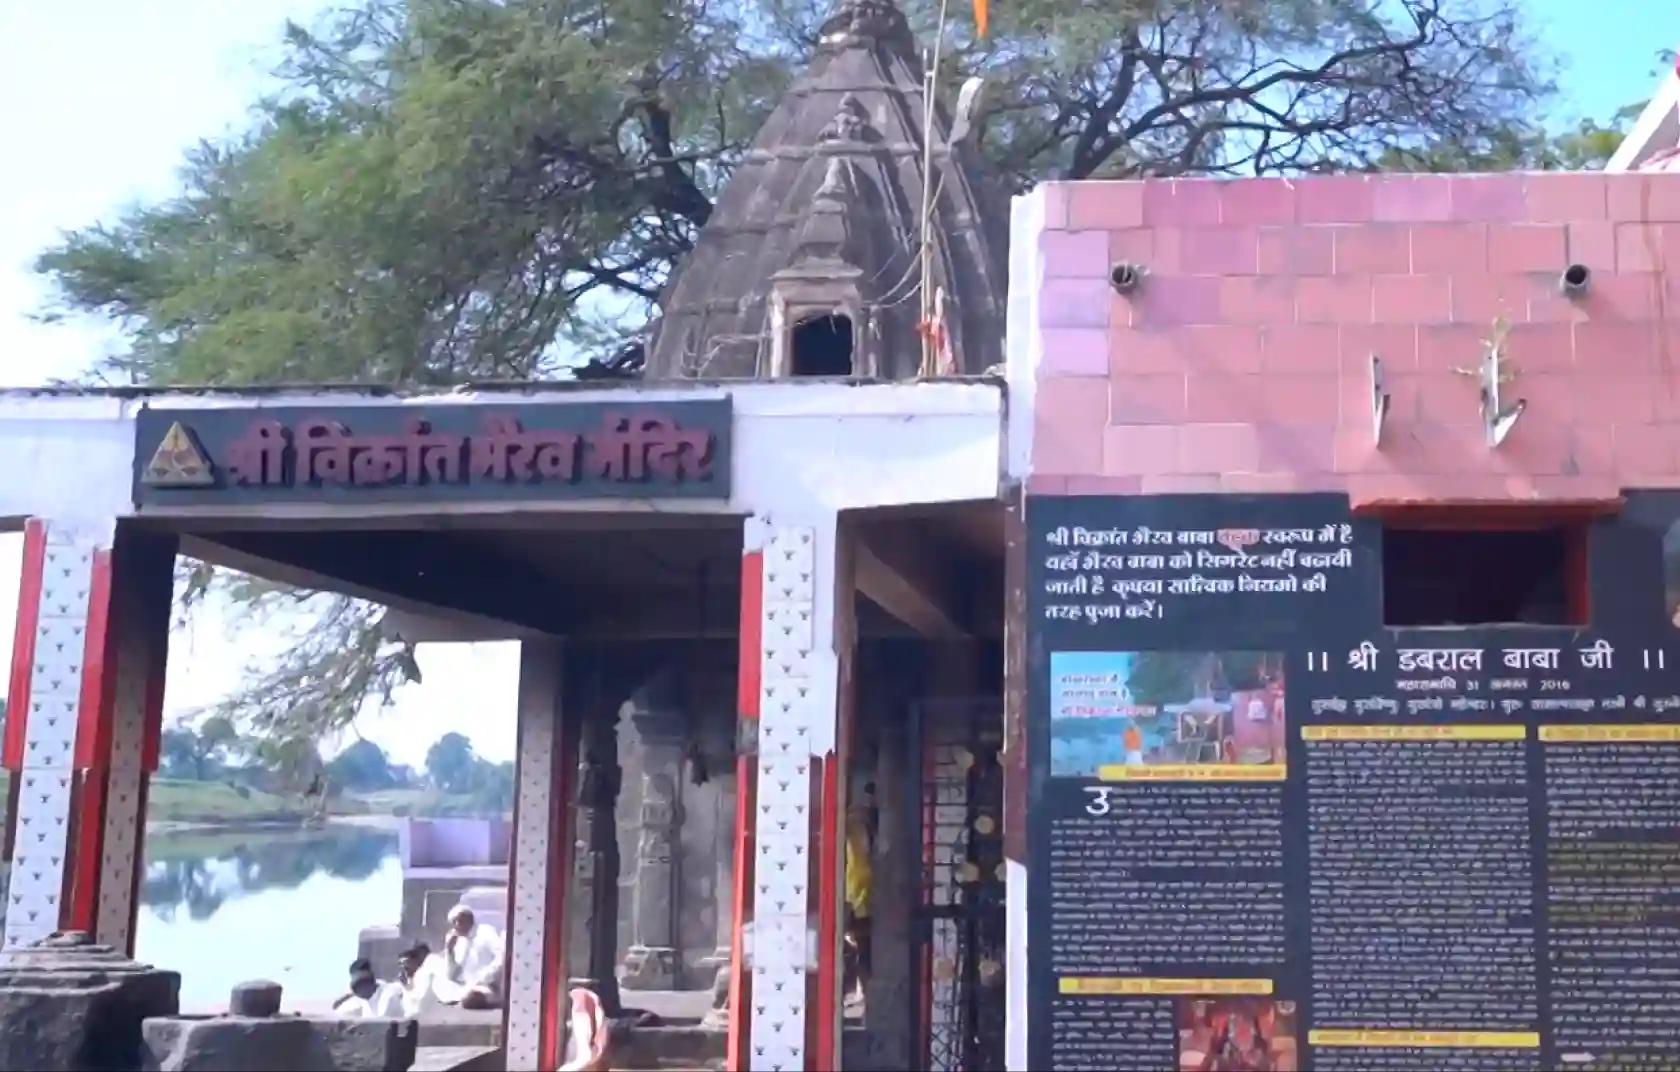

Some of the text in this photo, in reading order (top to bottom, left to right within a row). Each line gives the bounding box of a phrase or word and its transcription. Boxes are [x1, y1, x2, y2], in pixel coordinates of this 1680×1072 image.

[226, 417, 284, 485] श्री
[470, 411, 575, 481] भैरव
[586, 410, 712, 481] मंदिर
[1045, 526, 1069, 546] श्री
[1168, 550, 1193, 569] को
[1045, 573, 1088, 594] जाती
[1111, 578, 1164, 600] कृपया
[1302, 572, 1327, 593] की
[1044, 604, 1082, 620] तरह
[1348, 640, 1380, 672] श्री
[1397, 648, 1485, 672] डबराल
[1502, 648, 1561, 671] बाबा
[1579, 639, 1614, 670] जी
